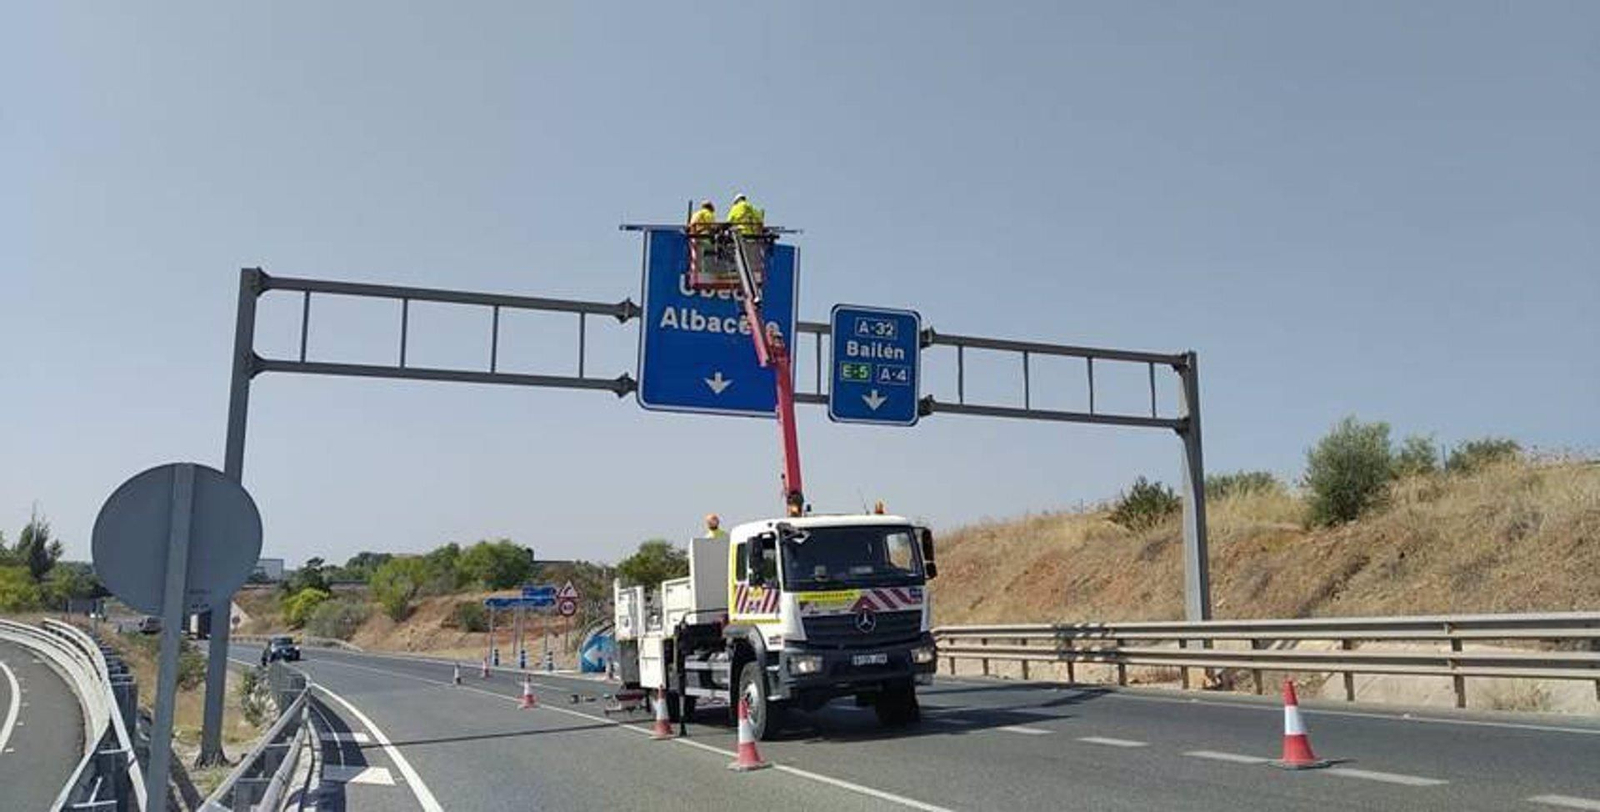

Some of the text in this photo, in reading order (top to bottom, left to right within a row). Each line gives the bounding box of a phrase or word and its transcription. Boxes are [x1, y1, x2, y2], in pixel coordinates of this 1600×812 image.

[660, 306, 783, 337] Albacee
[858, 320, 894, 336] A-32
[846, 340, 905, 360] Bailén
[842, 364, 907, 381] E-5 A-4
